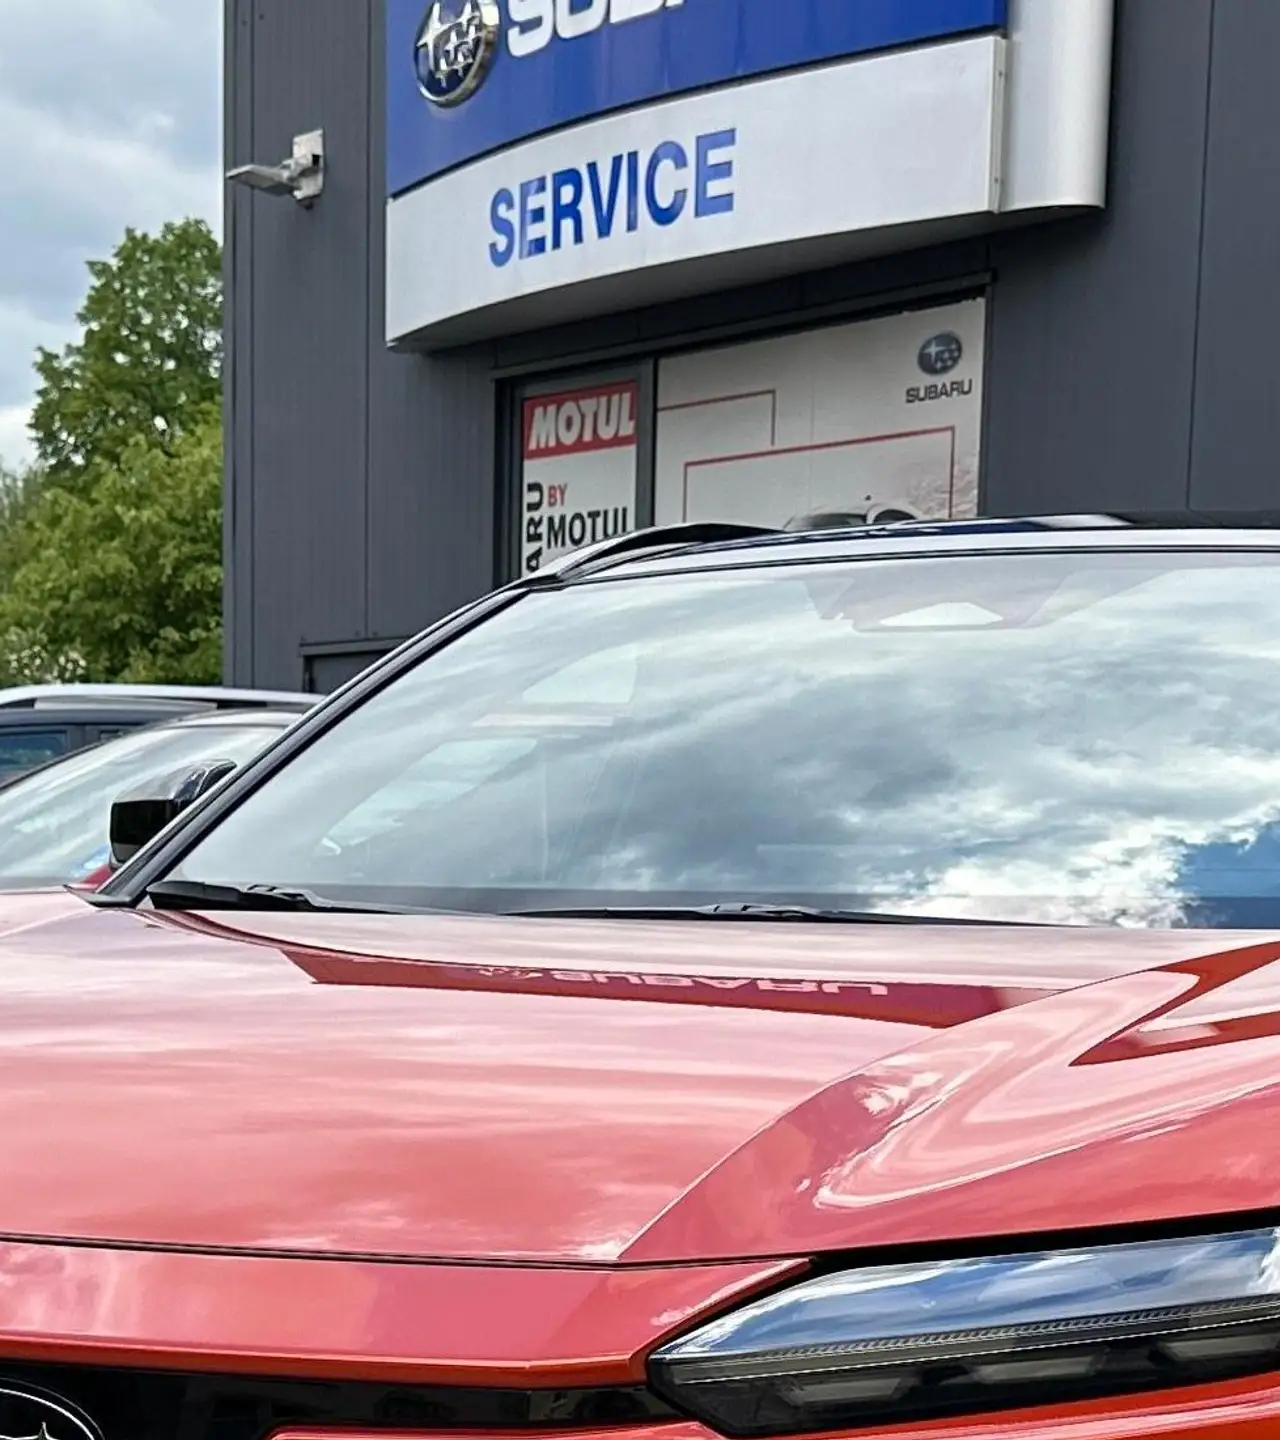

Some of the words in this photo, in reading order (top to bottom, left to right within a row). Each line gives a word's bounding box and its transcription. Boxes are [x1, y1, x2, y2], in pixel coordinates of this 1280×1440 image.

[489, 128, 736, 267] SERVICE
[906, 378, 973, 404] SUBARU
[529, 392, 636, 450] MOTUL
[548, 483, 568, 507] BY
